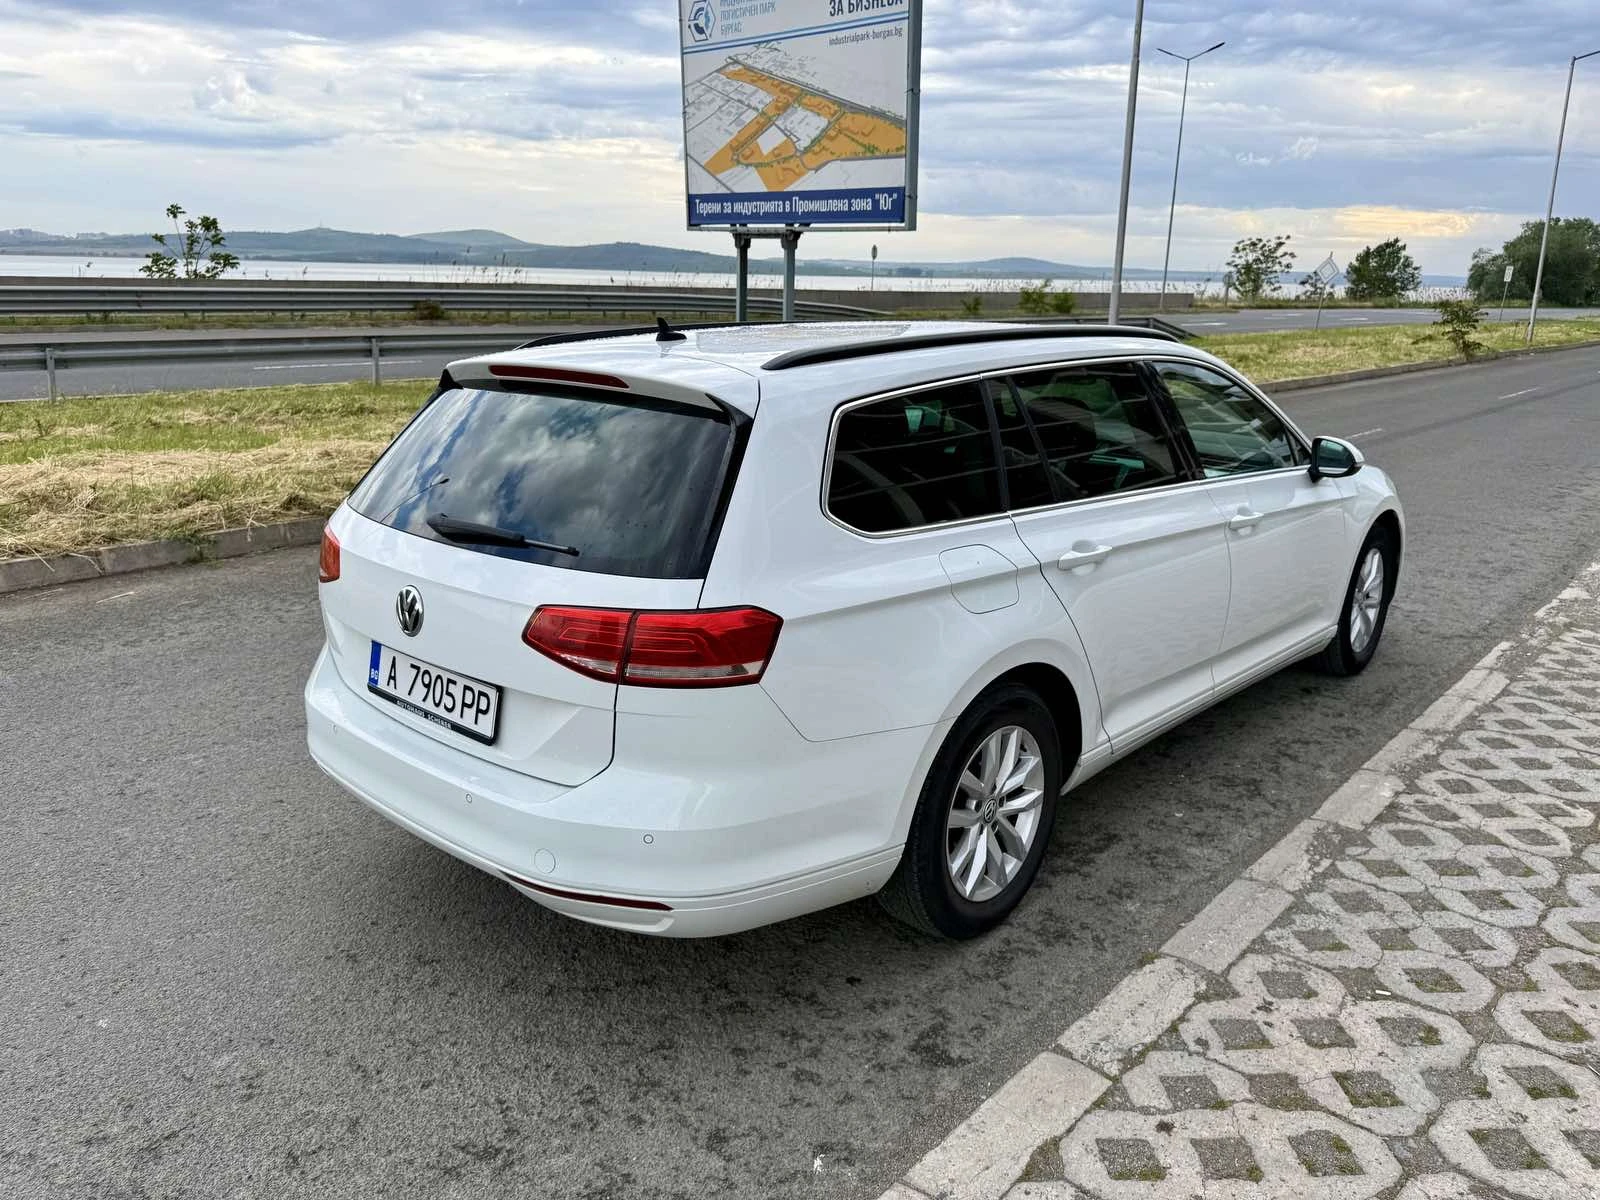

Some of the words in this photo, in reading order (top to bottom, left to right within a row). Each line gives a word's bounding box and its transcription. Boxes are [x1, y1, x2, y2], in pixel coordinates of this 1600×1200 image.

[695, 199, 722, 217] Терени
[723, 202, 732, 214] за
[733, 200, 783, 216] индустрията
[785, 200, 791, 213] в
[792, 196, 849, 216] Промишлена
[850, 197, 873, 212] зона
[875, 192, 898, 211] "Юг"
[370, 667, 379, 681] BG
